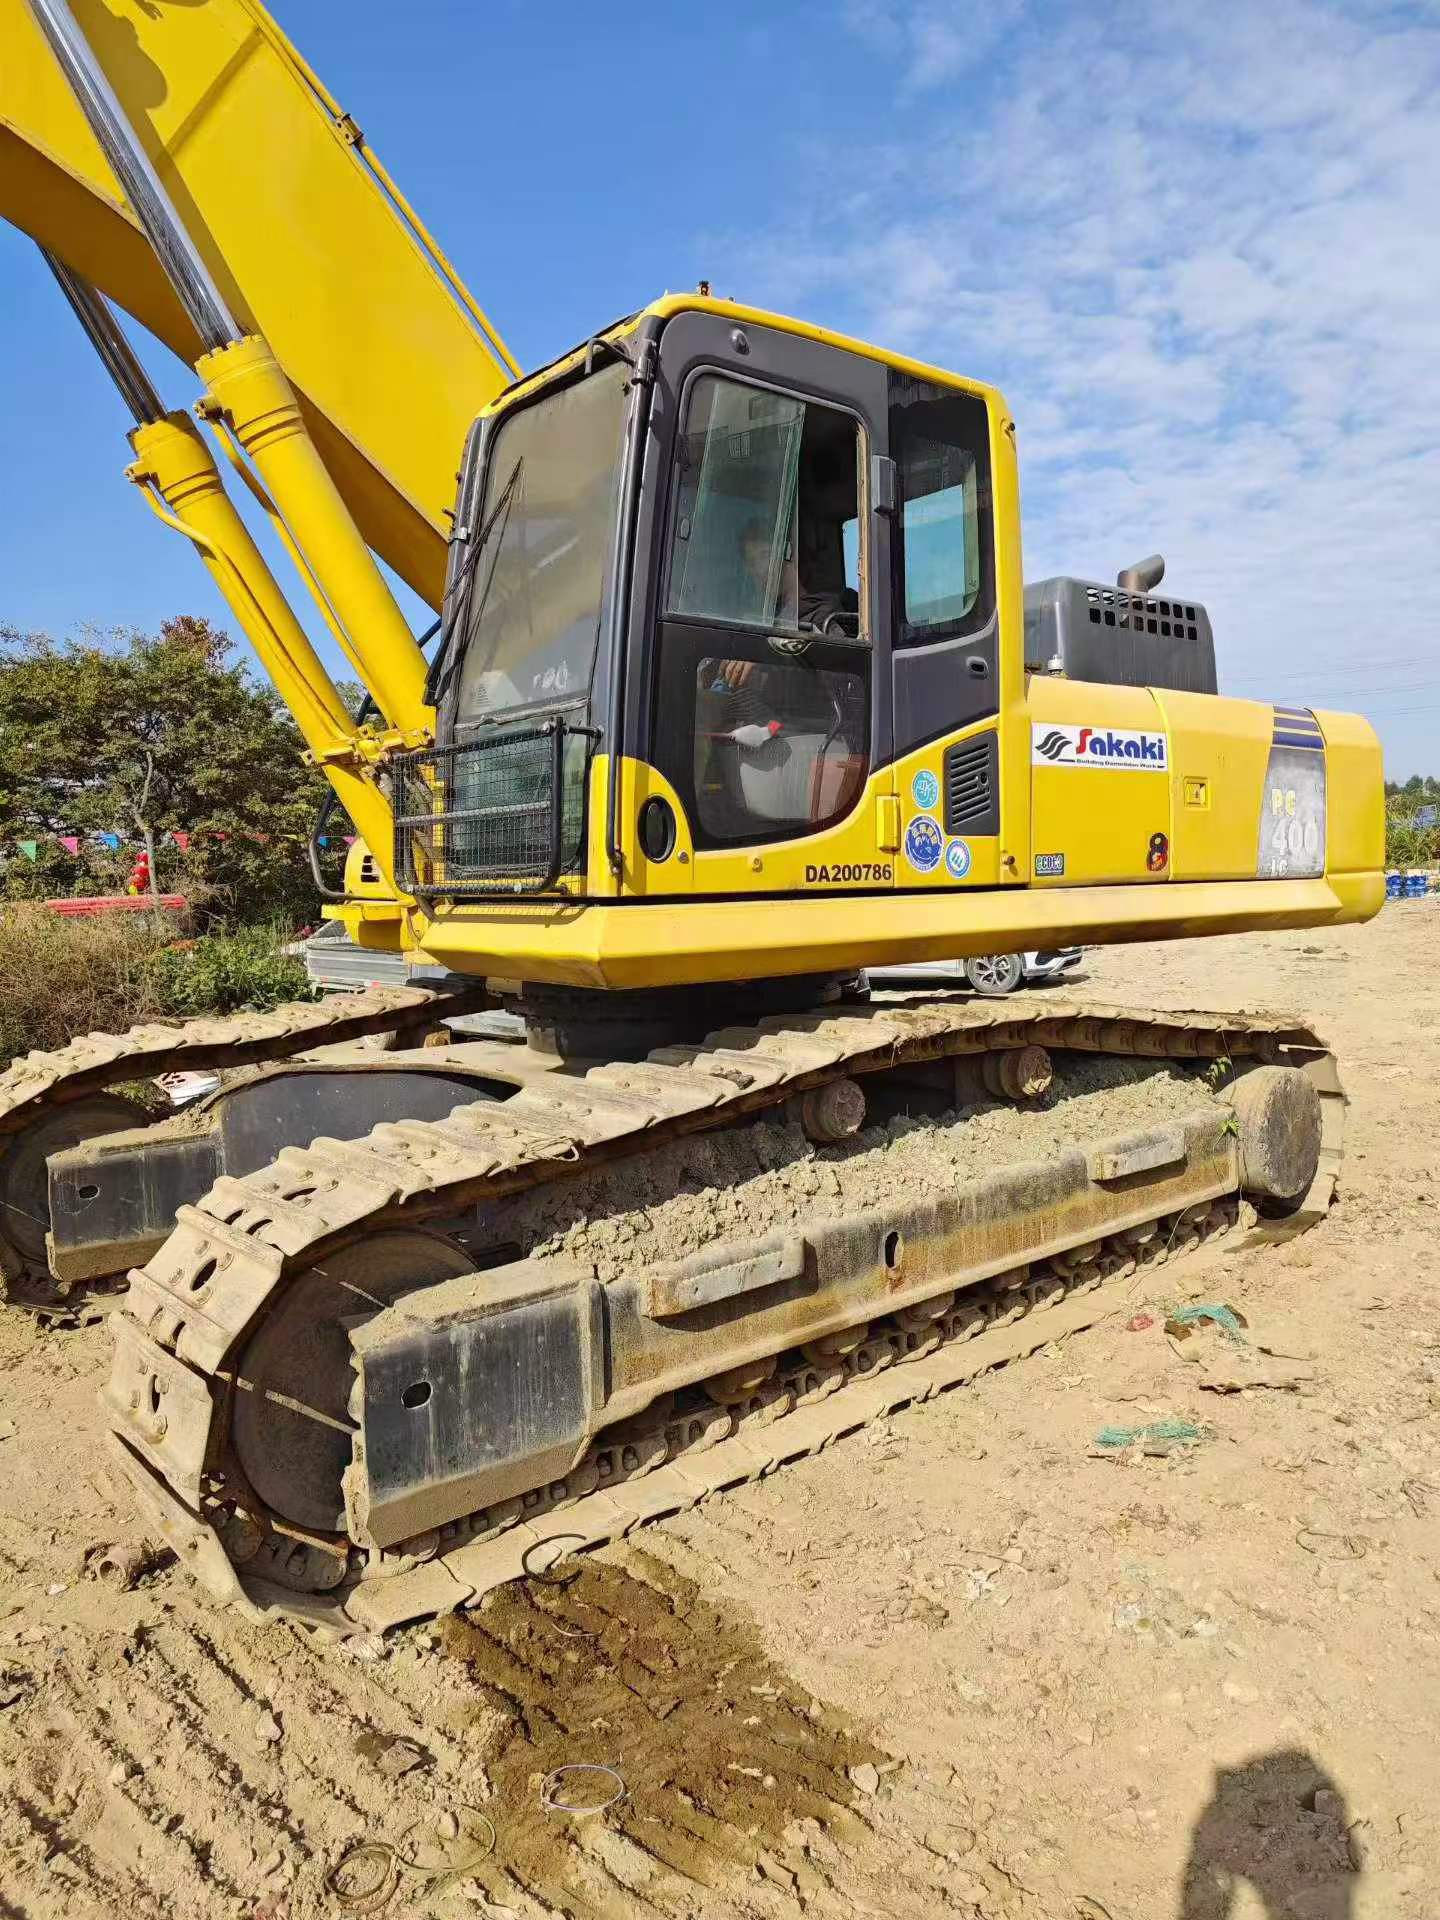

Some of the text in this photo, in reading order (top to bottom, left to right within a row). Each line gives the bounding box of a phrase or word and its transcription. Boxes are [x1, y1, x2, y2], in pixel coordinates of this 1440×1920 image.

[1076, 729, 1164, 760] Sakaki
[1272, 817, 1318, 858] 400
[806, 863, 892, 882] DA200786
